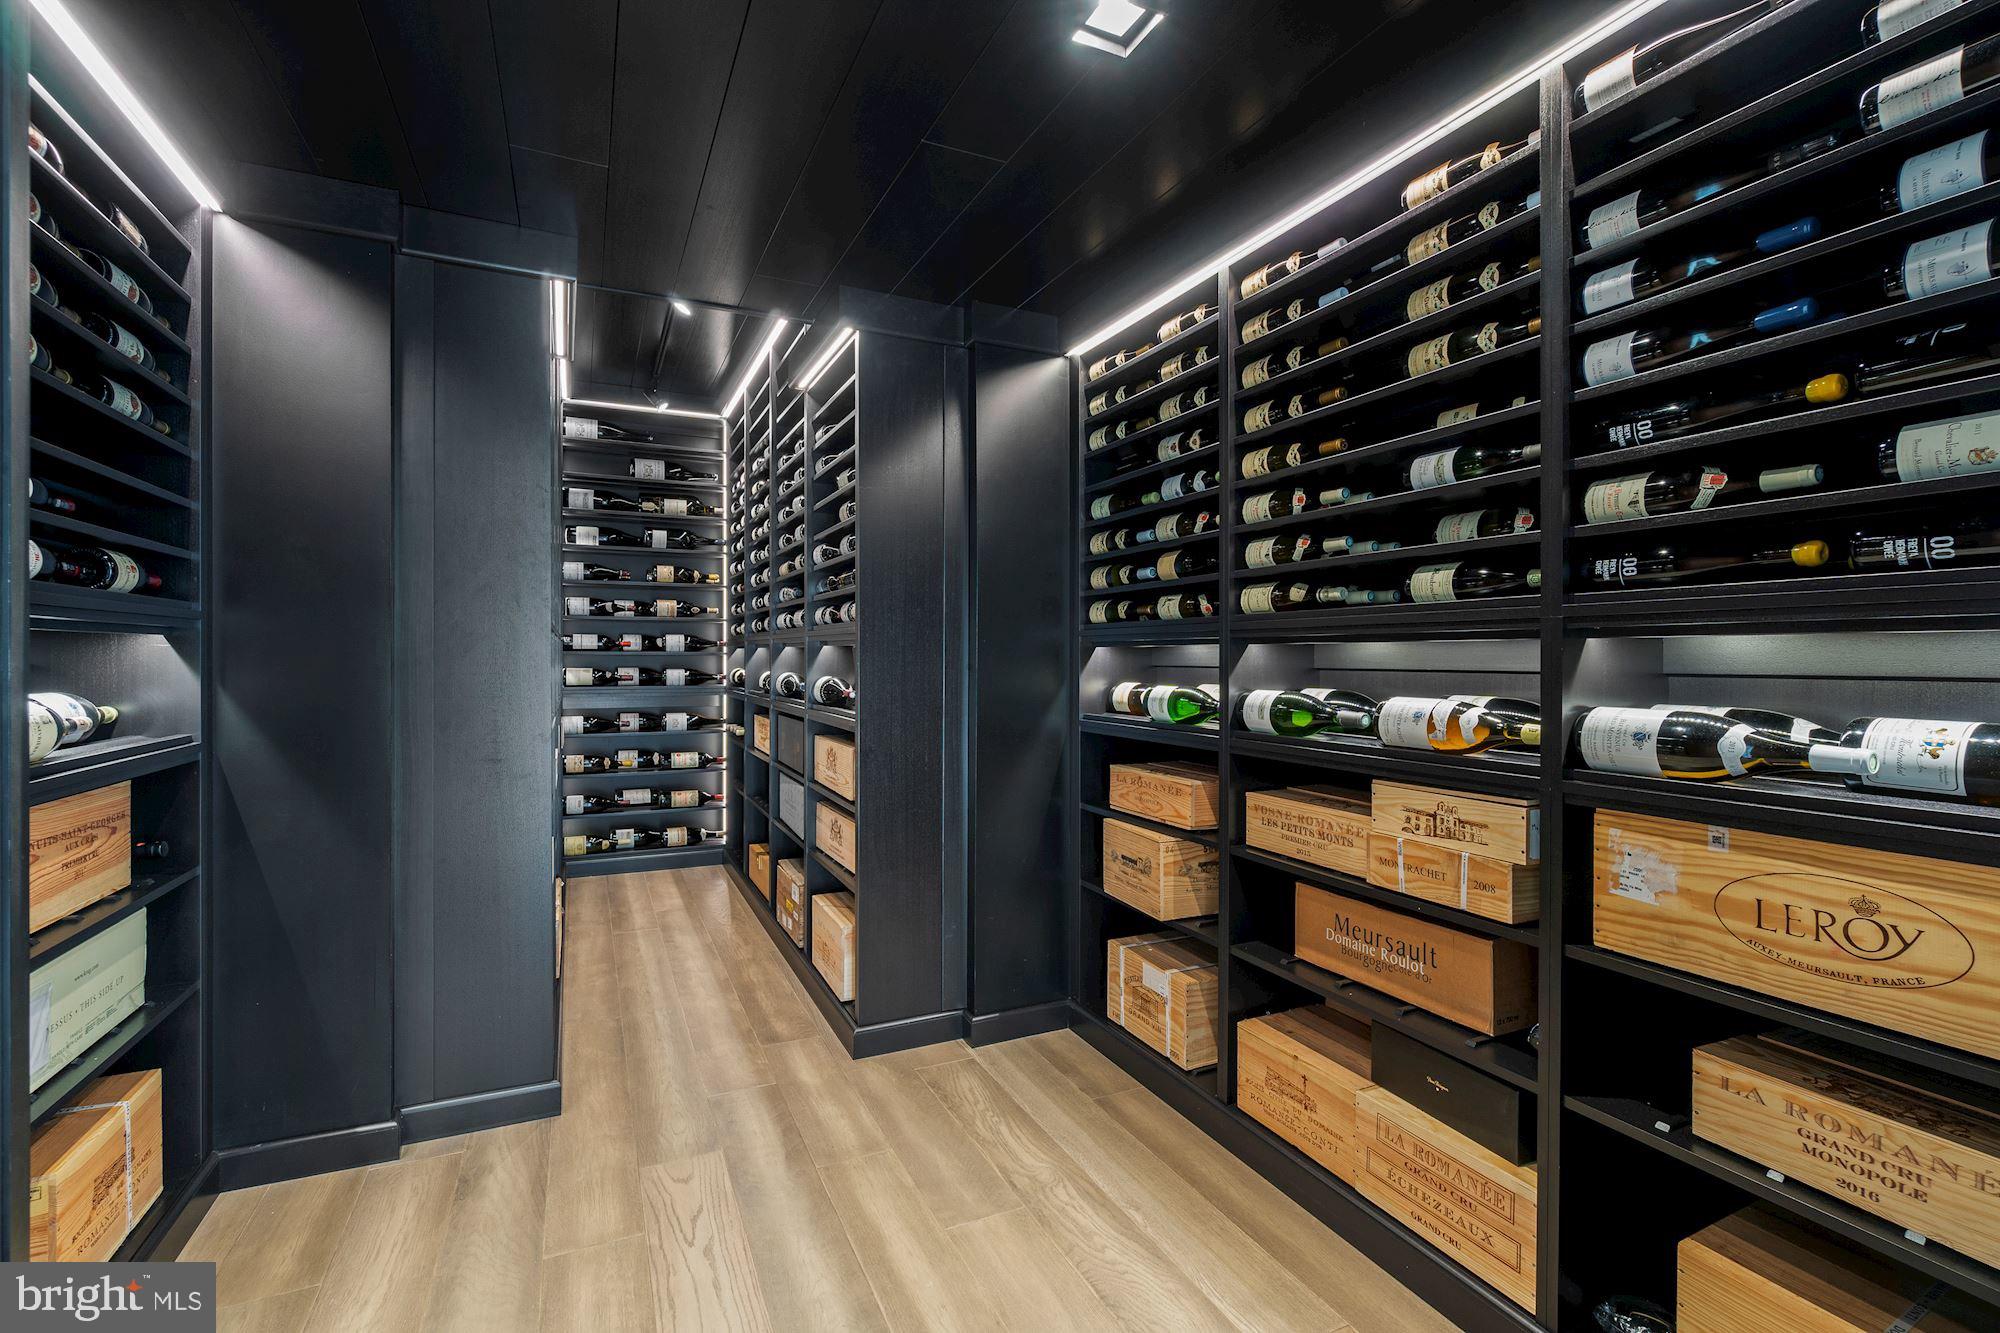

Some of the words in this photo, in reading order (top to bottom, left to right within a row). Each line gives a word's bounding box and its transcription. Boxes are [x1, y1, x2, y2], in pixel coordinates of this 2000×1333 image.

[1253, 803, 1366, 839] VOSNE-ROMANÉE
[1260, 816, 1280, 830] LES
[1280, 819, 1316, 842] PETITS
[1317, 829, 1354, 849] MONTS
[1473, 879, 1497, 895] 2008
[1325, 926, 1377, 958] Domaine
[1380, 947, 1426, 976] Roulot
[1333, 912, 1438, 970] Meursault
[1754, 897, 1926, 962] LEROY
[1872, 975, 1926, 988] FRANCE
[1719, 1075, 1768, 1107] LA
[1384, 1123, 1407, 1152] LA
[1412, 1142, 1507, 1213] ROMANÉE
[1797, 1126, 1876, 1166] GRAND
[1881, 1160, 1935, 1189] CRU
[1802, 1142, 1929, 1204] MONOPOLE
[1386, 1166, 1496, 1250] ÉCHEZEAUX
[1403, 1160, 1448, 1194] GRAND
[1449, 1190, 1479, 1214] CRU
[1835, 1177, 1881, 1204] 2016
[1410, 1209, 1444, 1237] GRAND
[1442, 1233, 1463, 1251] CRU
